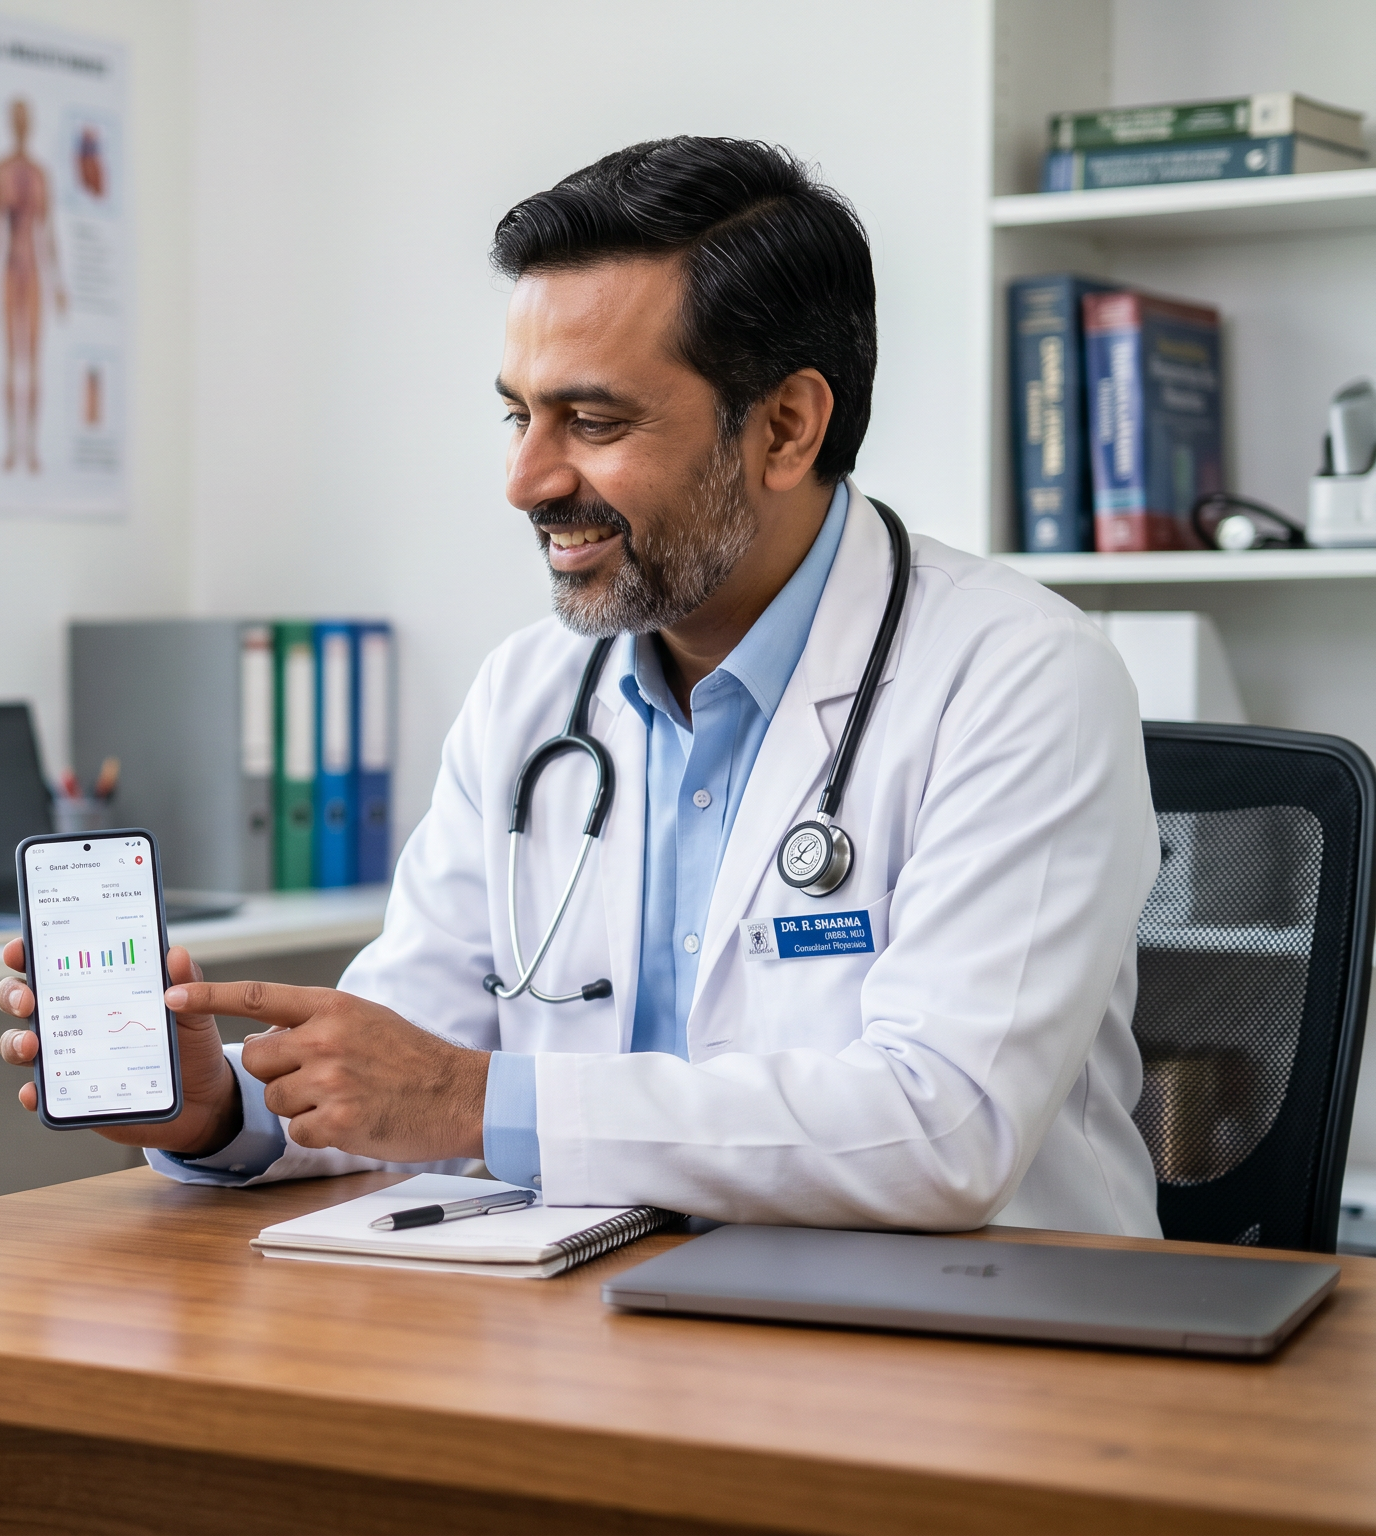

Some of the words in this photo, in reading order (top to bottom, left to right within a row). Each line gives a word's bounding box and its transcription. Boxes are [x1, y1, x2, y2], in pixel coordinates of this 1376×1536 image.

[780, 921, 800, 932] DR.
[801, 920, 813, 931] R.
[814, 917, 862, 930] SHARMA
